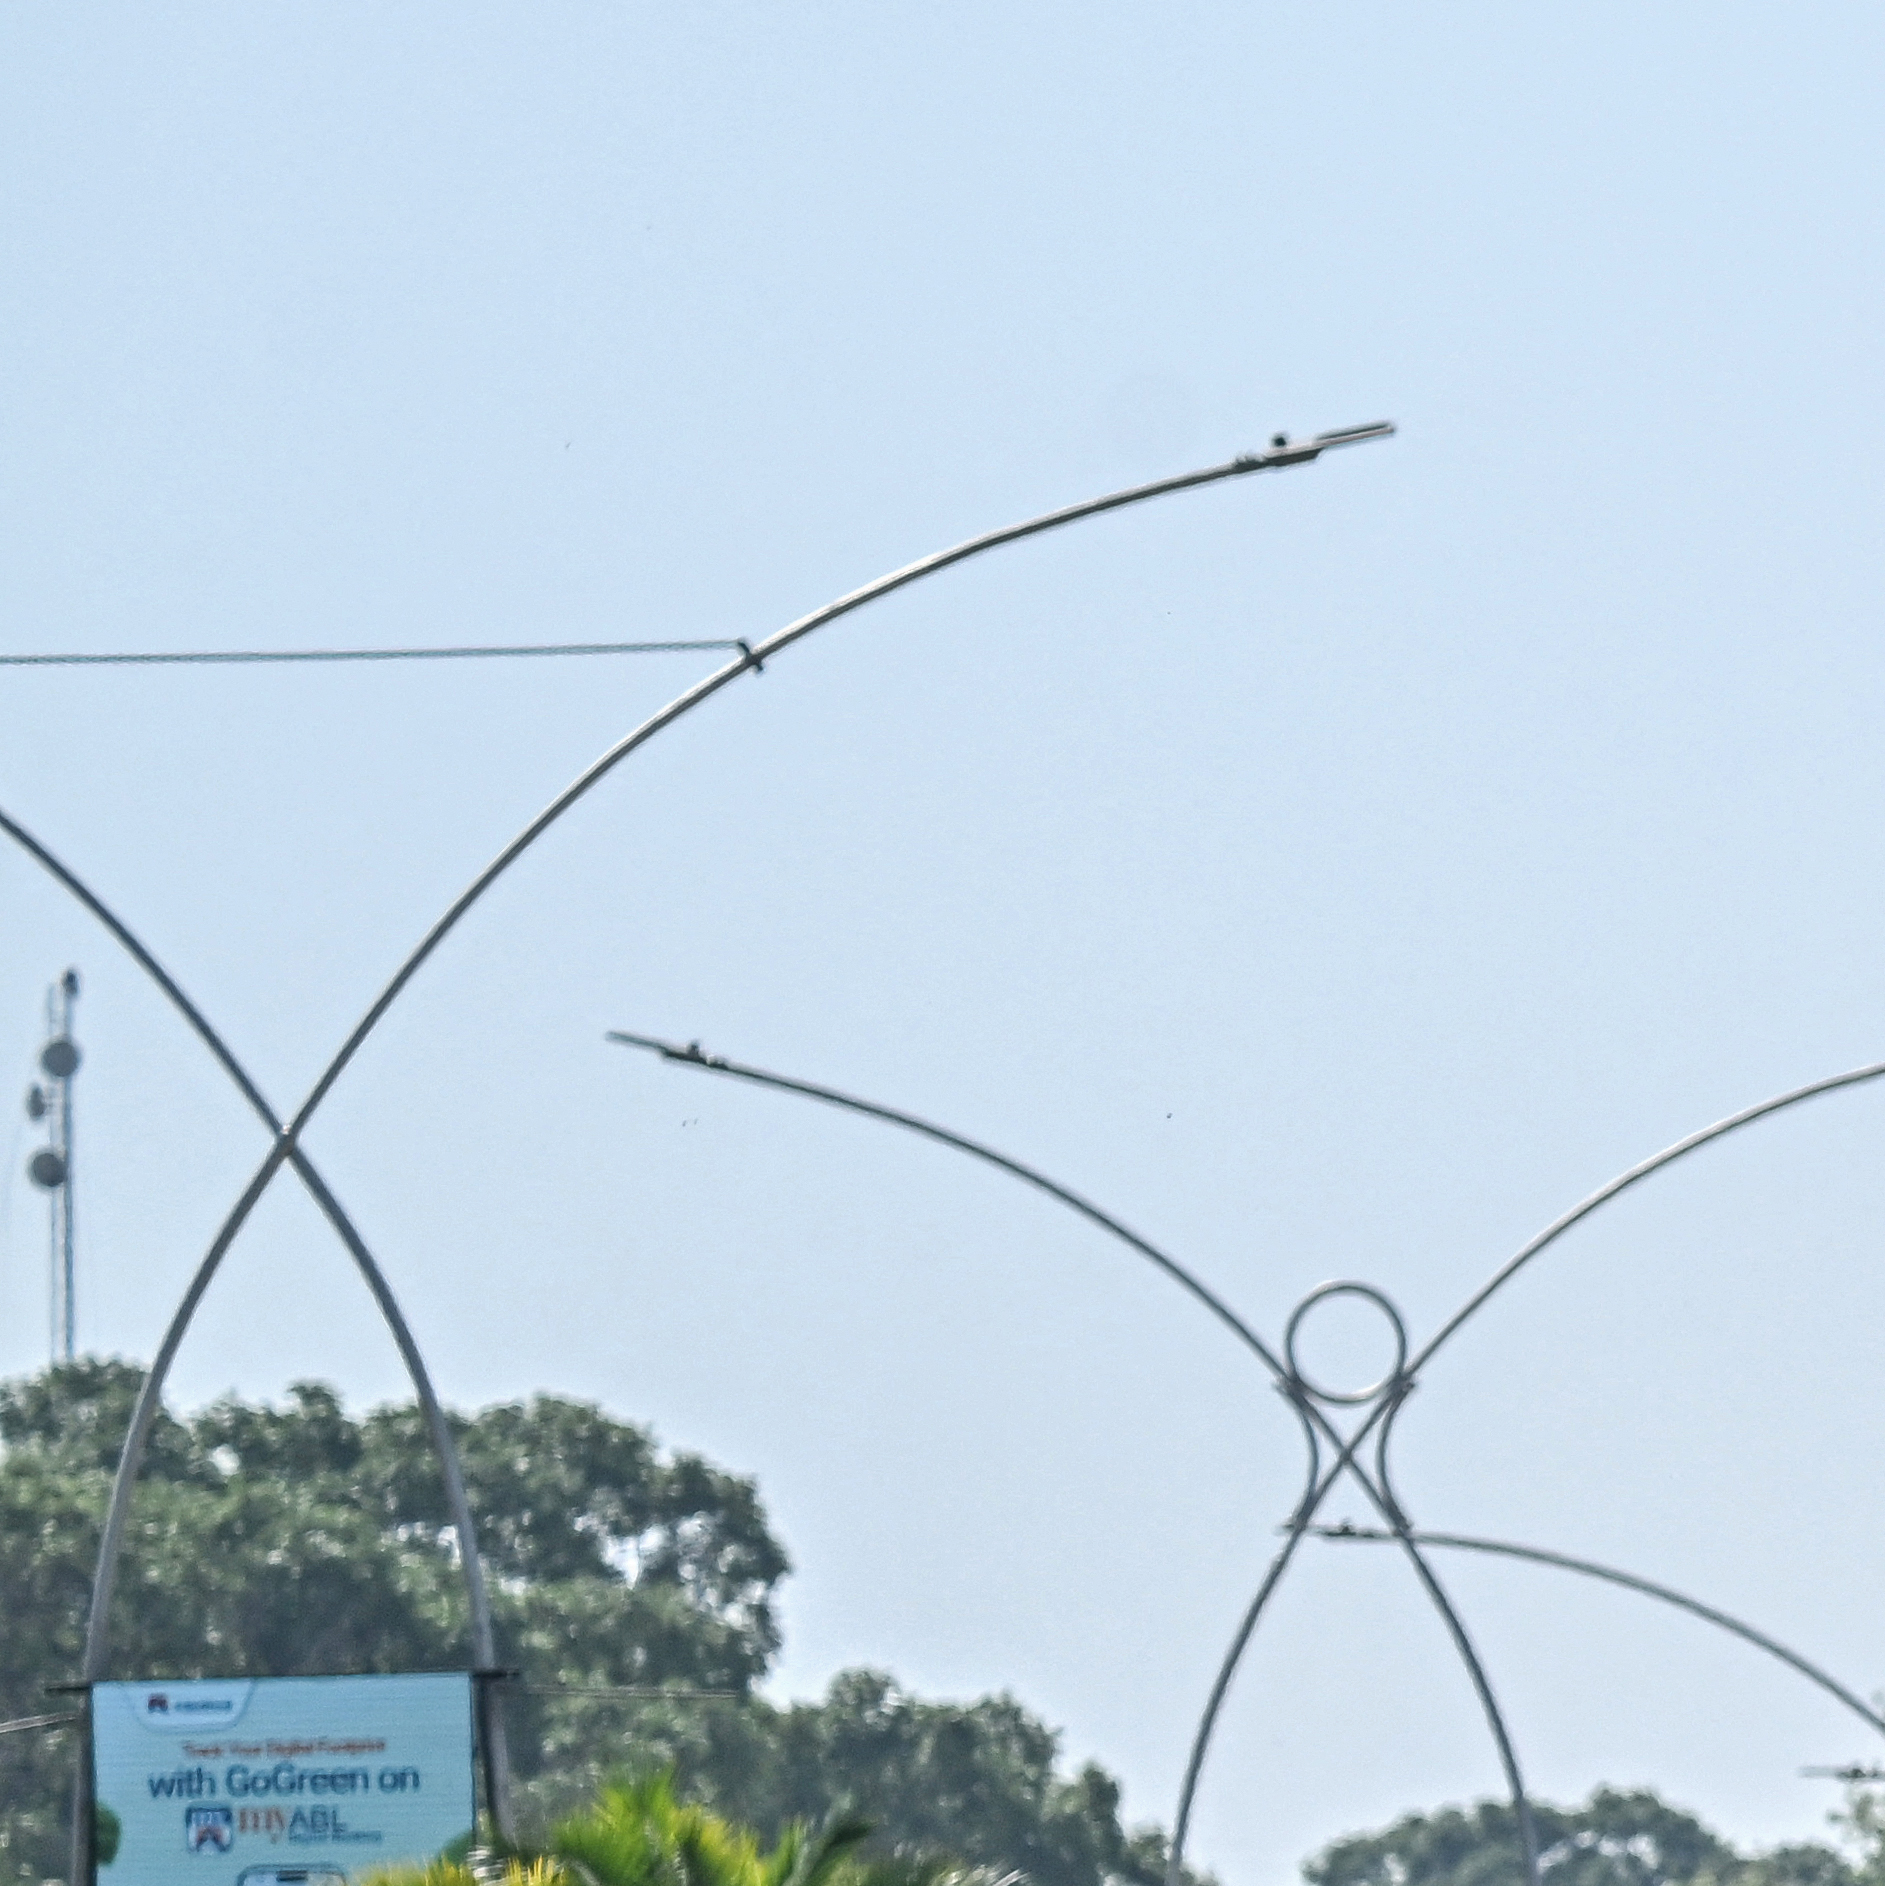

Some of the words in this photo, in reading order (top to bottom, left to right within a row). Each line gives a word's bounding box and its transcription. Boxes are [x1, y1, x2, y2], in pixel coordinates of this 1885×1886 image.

[149, 1766, 216, 1798] with
[226, 1763, 370, 1798] GoGreen
[377, 1766, 420, 1794] on
